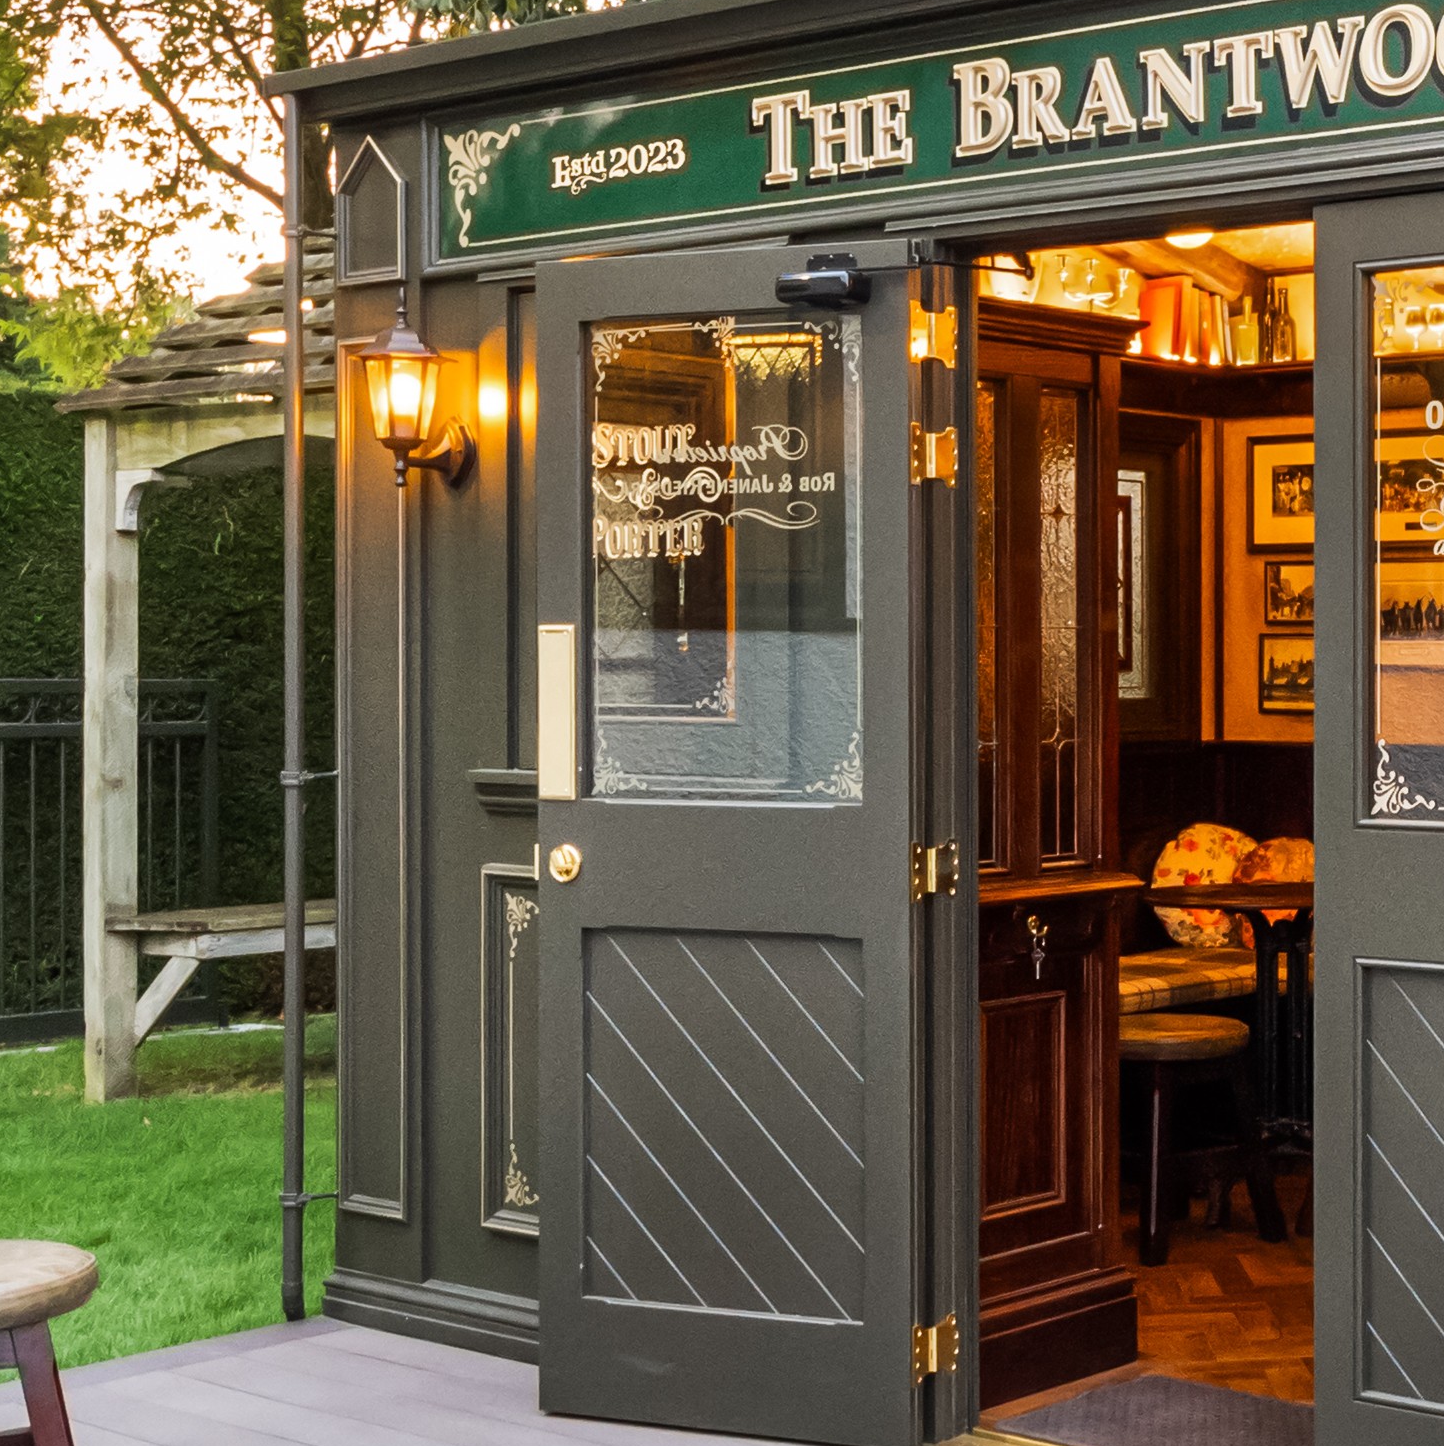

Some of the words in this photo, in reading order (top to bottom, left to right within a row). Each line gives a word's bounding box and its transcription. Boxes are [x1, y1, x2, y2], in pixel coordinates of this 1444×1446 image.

[609, 138, 686, 179] 2023
[751, 89, 913, 186] THE
[592, 422, 696, 468] STOUT
[592, 516, 705, 559] PORTER
